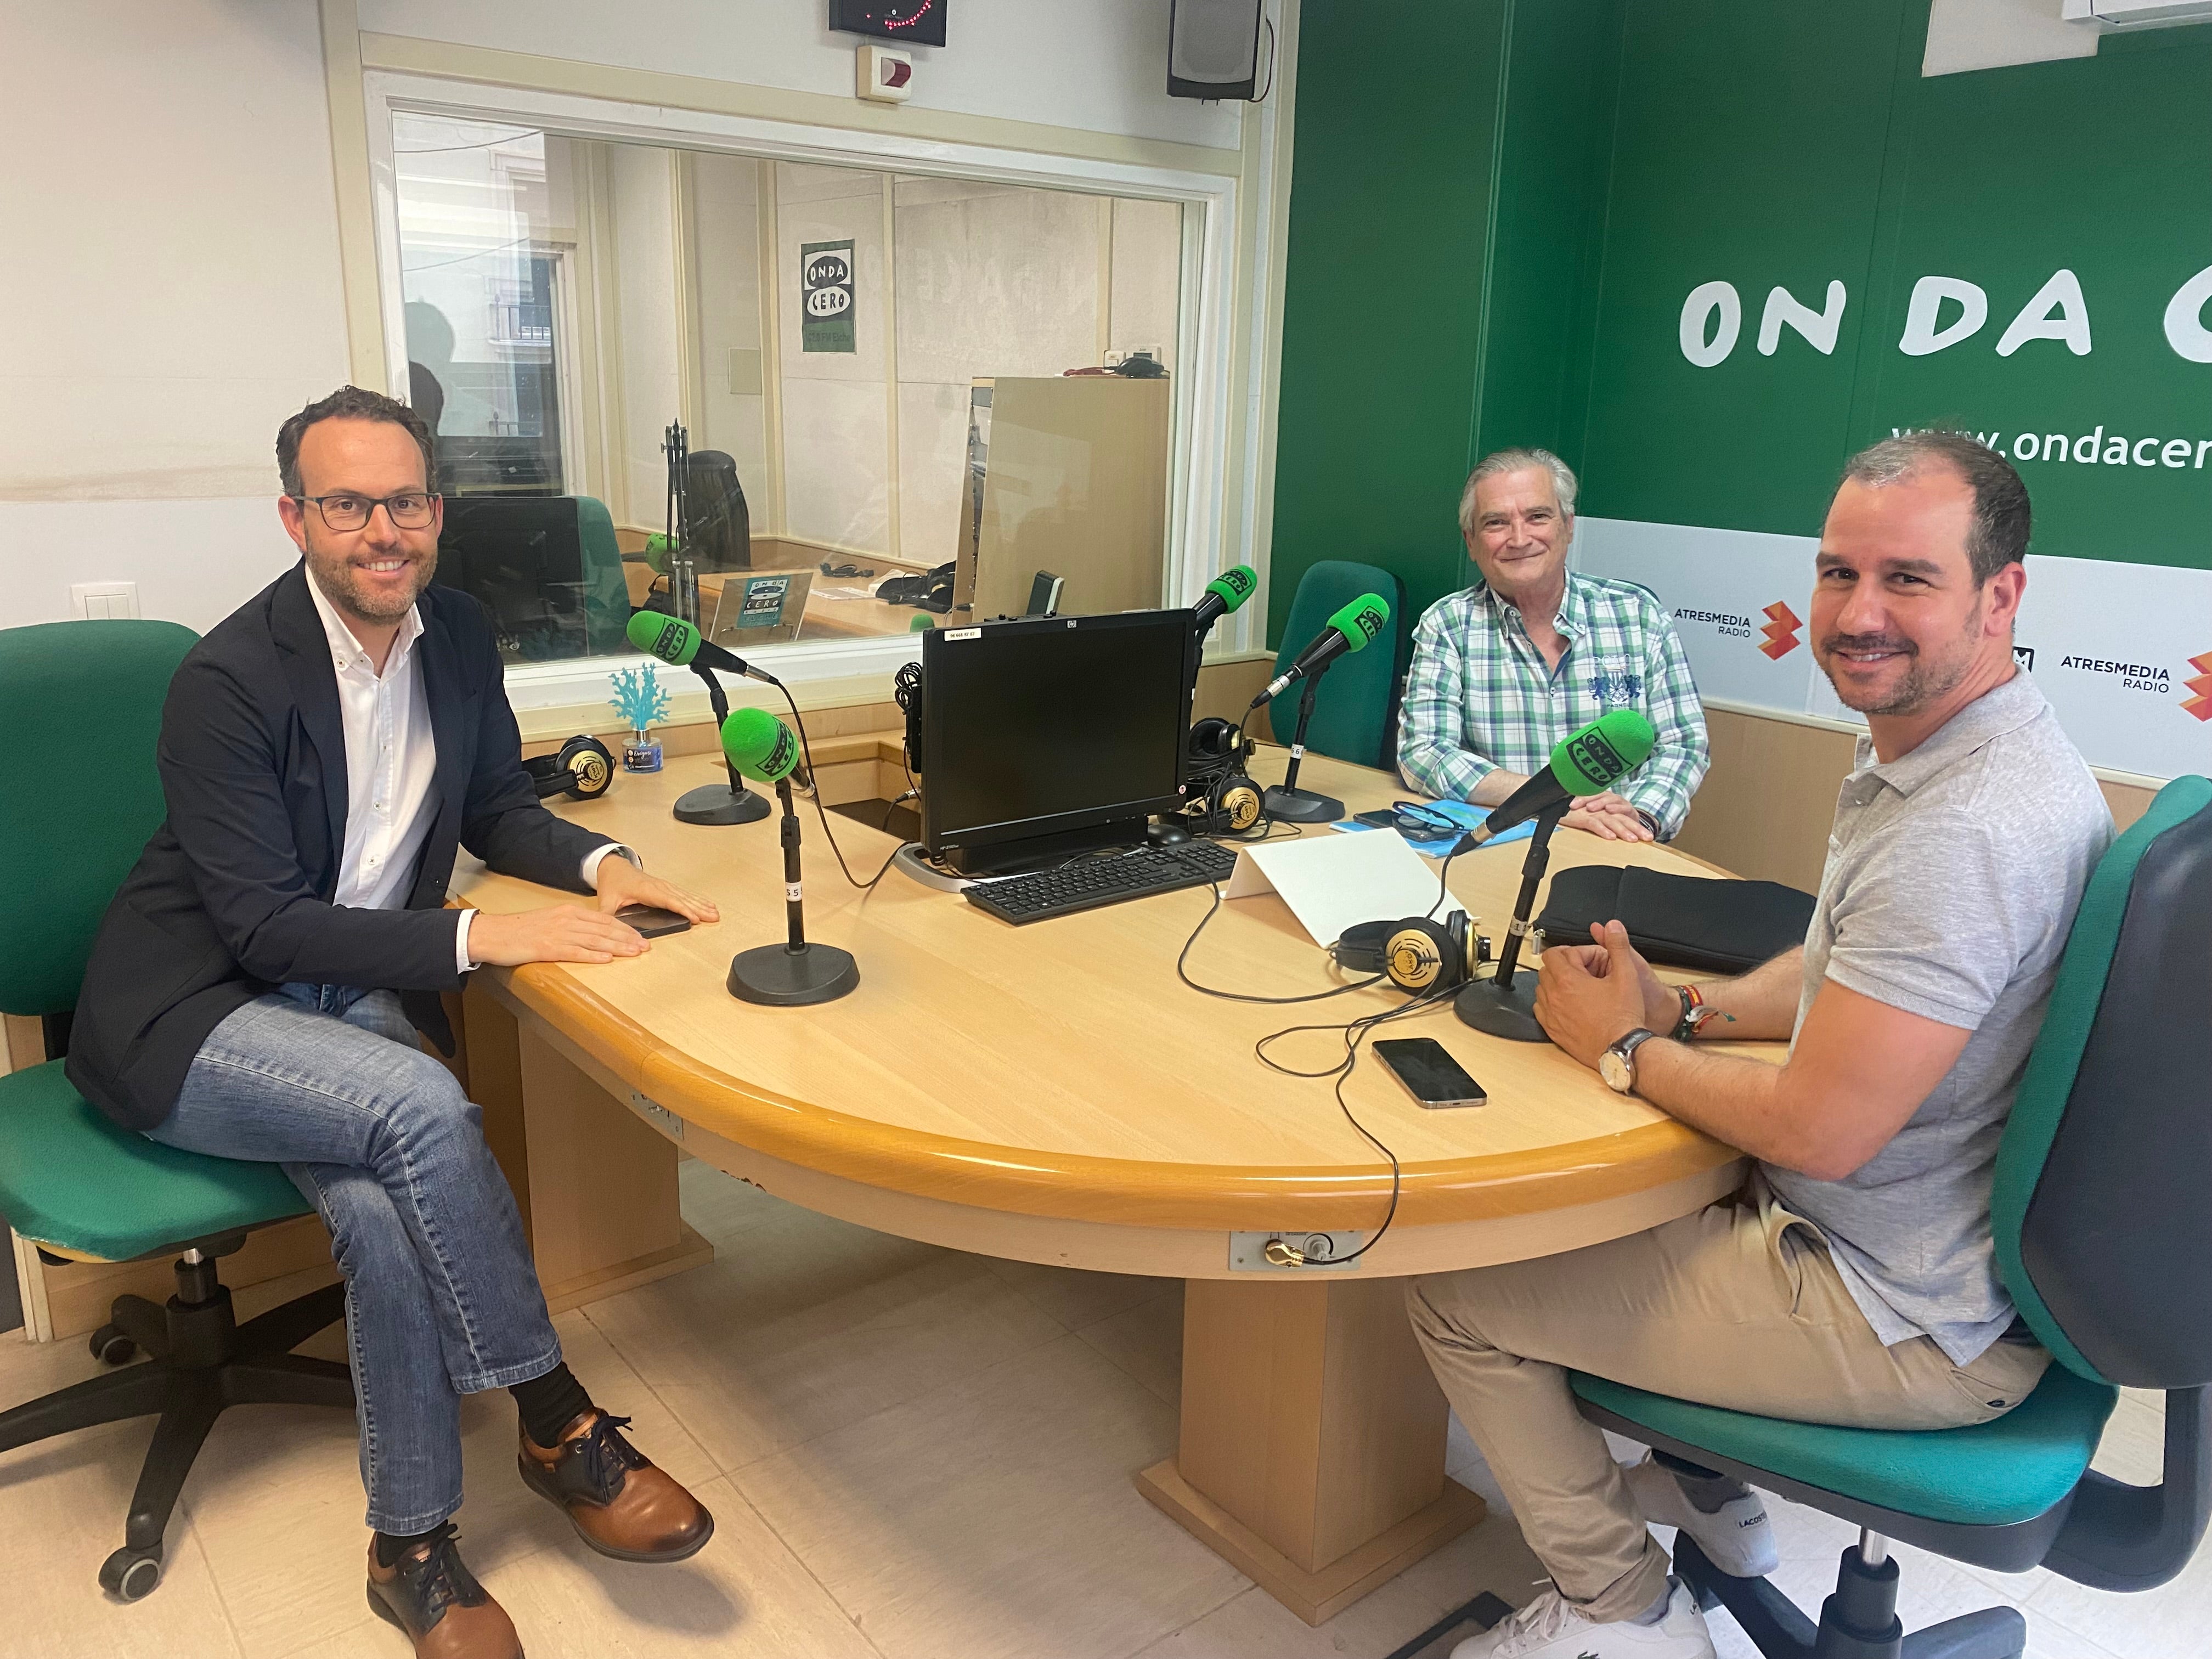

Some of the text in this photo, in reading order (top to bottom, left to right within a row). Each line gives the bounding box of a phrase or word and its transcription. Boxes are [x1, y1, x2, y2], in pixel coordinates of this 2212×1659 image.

[810, 264, 844, 281] ONDA
[812, 292, 845, 311] CERO
[1679, 269, 2092, 368] ONDA
[746, 600, 778, 608] CERO
[1674, 608, 1751, 628] ATRESMEDIA
[658, 625, 674, 652] ONDA
[668, 630, 684, 656] CERO
[1718, 626, 1751, 638] RADIO
[2061, 656, 2176, 681] ATRESMEDIA
[2123, 678, 2169, 693] RADIO
[1576, 747, 1608, 780] CERO
[1588, 736, 1620, 771] ONDA
